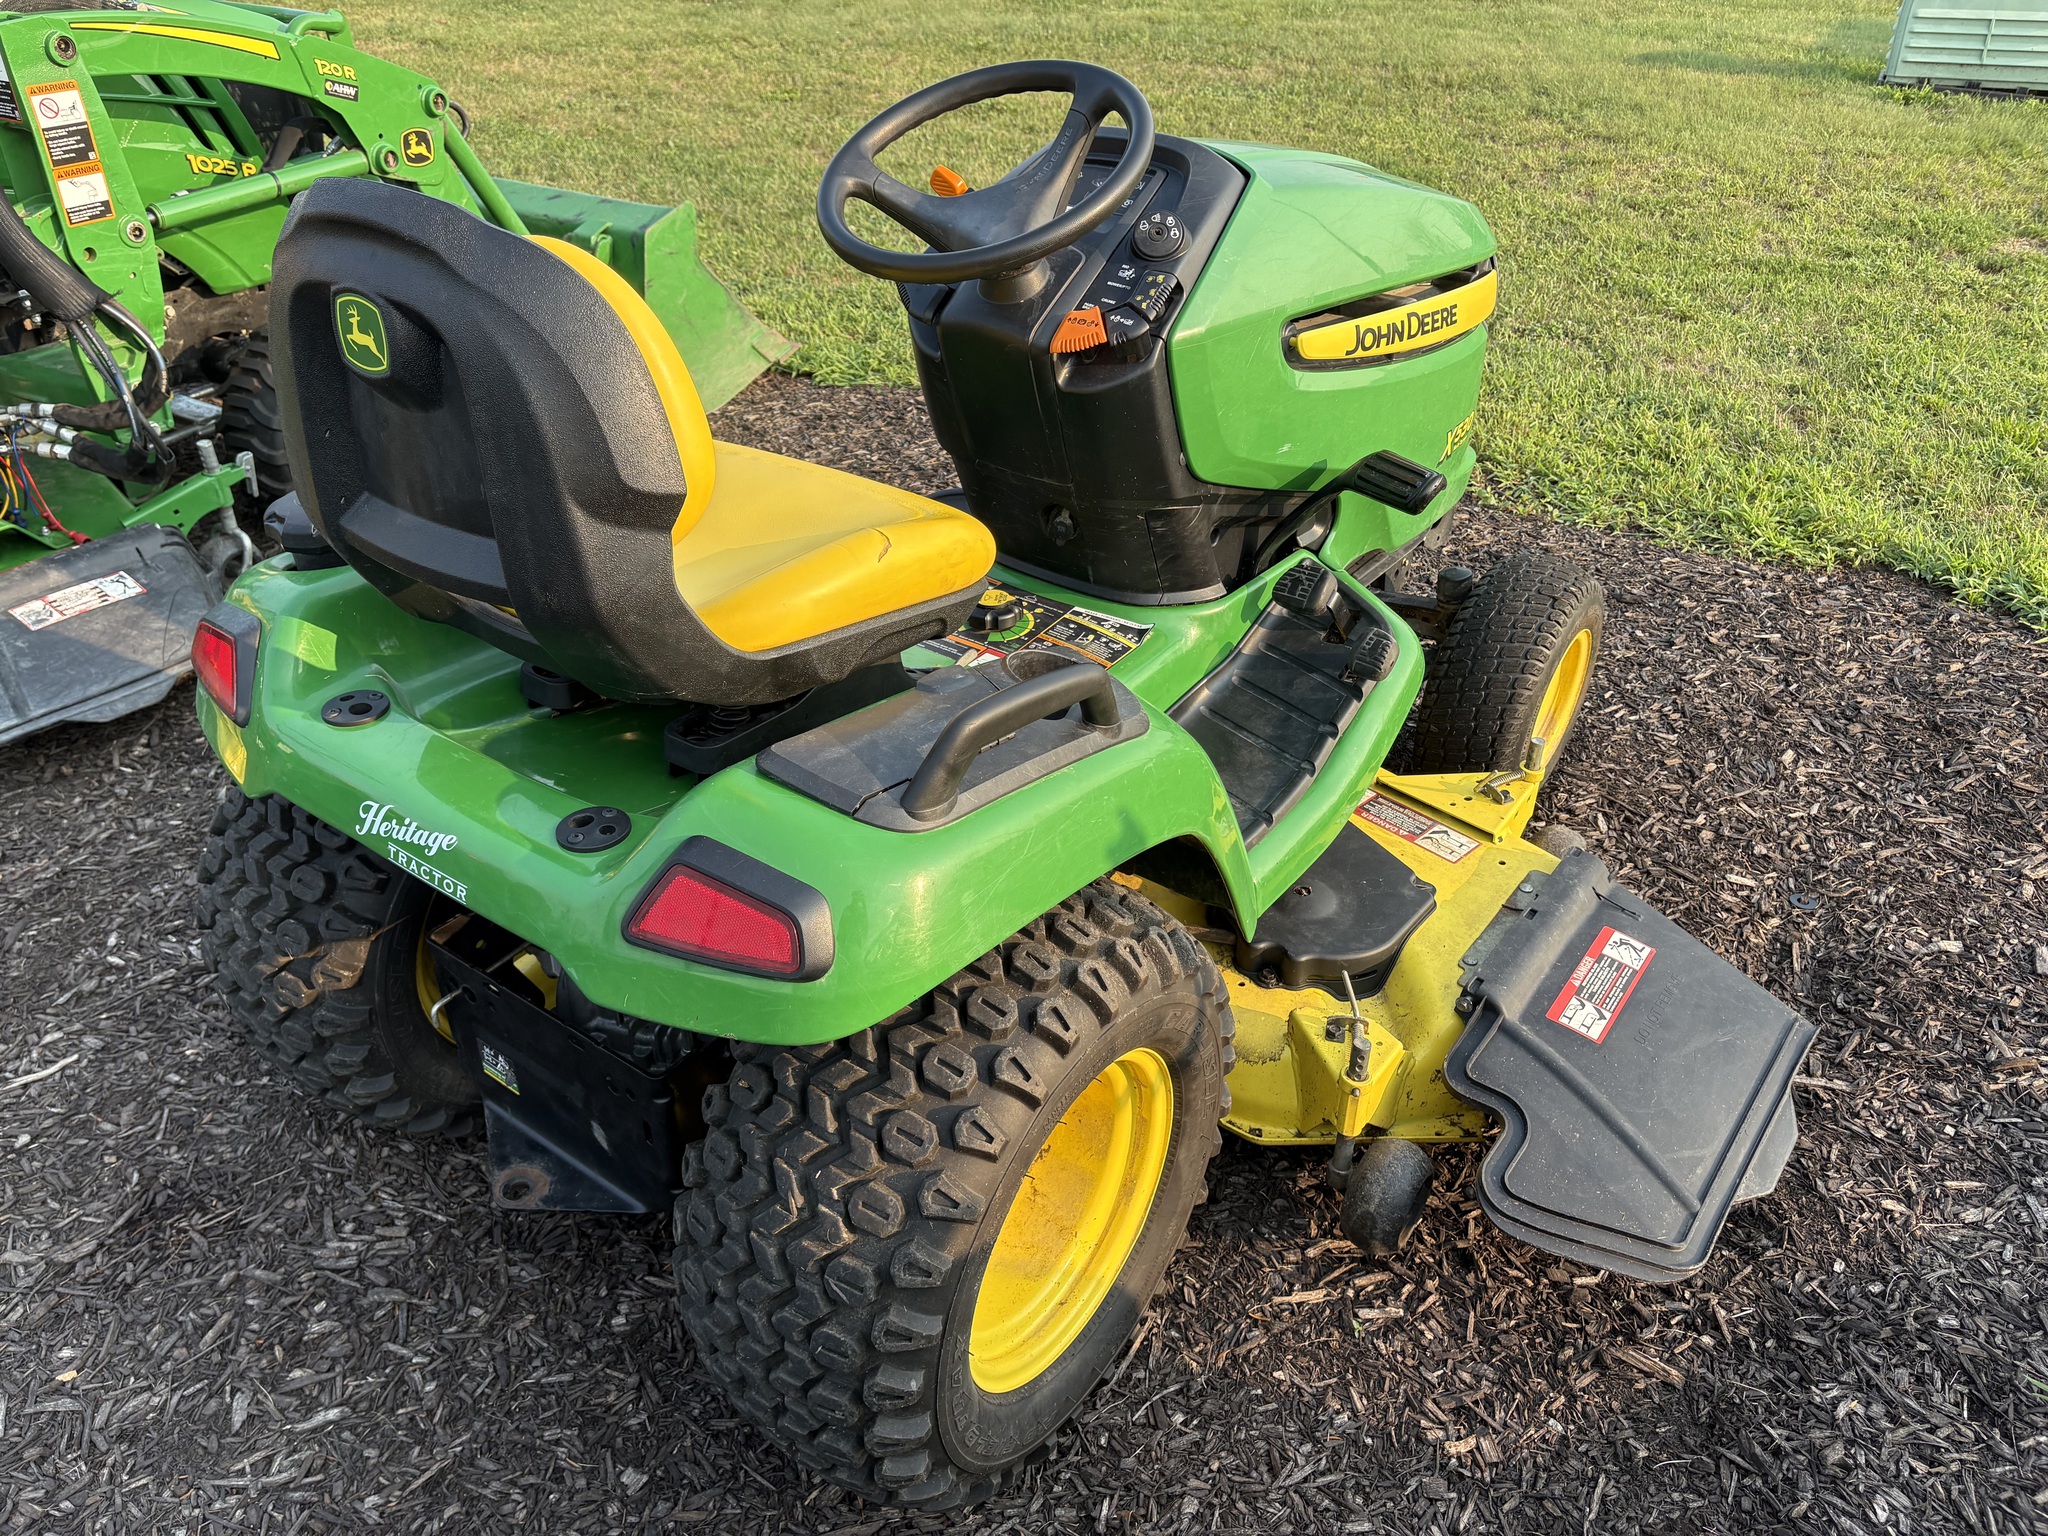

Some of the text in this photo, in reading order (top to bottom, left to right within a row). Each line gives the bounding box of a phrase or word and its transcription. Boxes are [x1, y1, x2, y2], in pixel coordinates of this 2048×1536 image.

[36, 81, 75, 94] WARNING
[63, 164, 100, 177] WARNING
[1344, 303, 1458, 356] JOHN DEERE
[355, 801, 458, 856] Heritage
[1360, 811, 1398, 832] DANGER
[388, 845, 467, 901] TRACTOR
[1572, 955, 1595, 980] DANGER
[1162, 1008, 1218, 1119] CARLISLE
